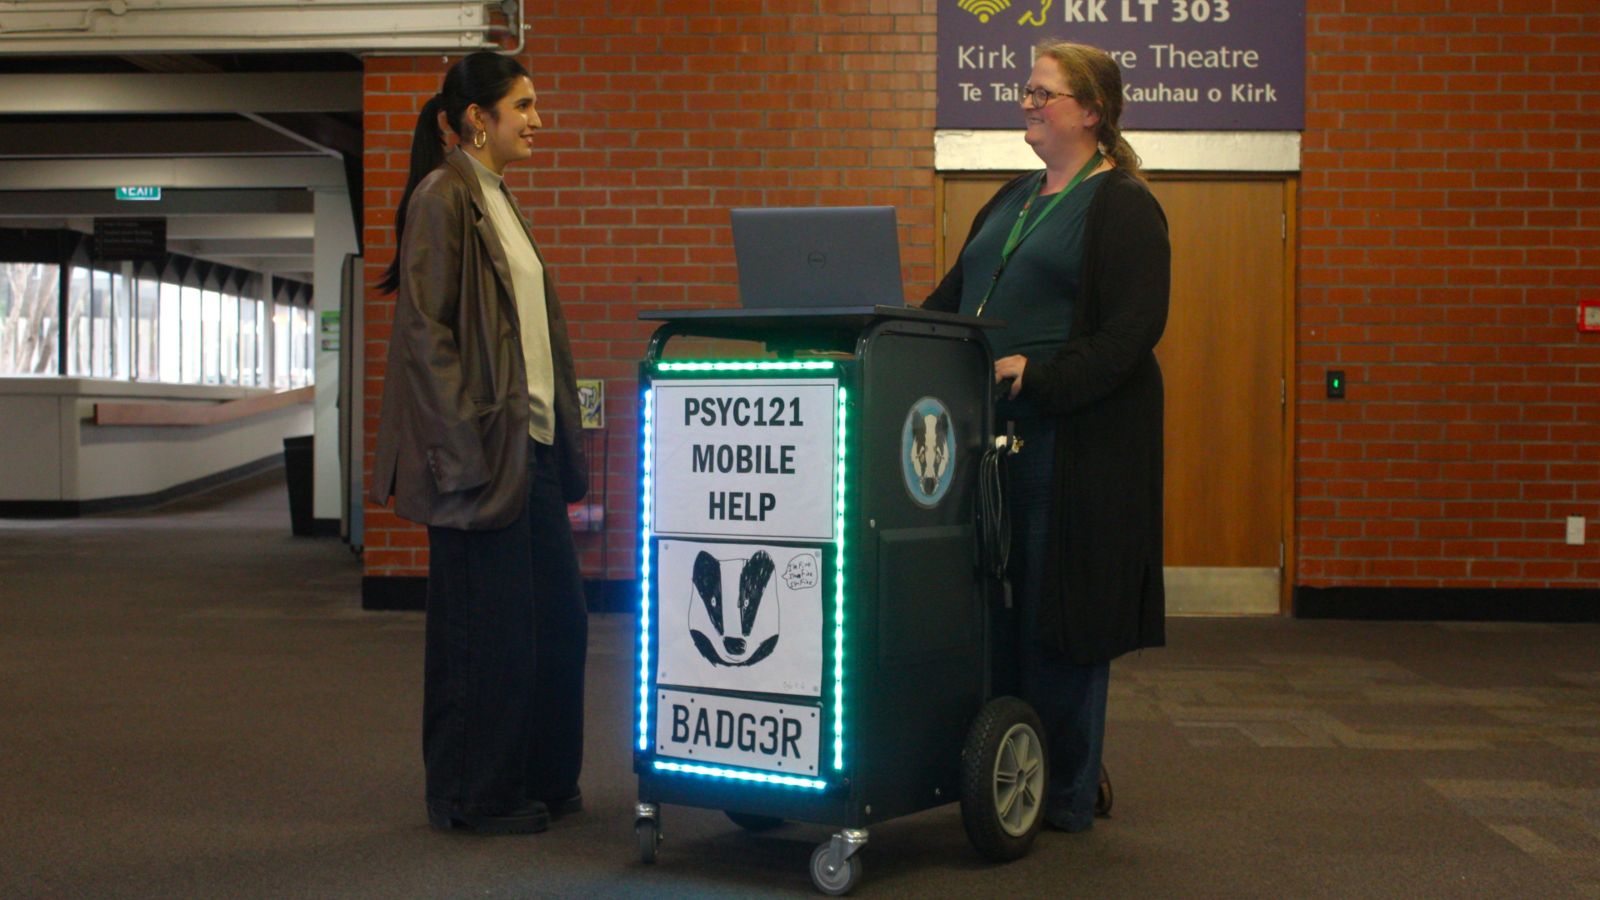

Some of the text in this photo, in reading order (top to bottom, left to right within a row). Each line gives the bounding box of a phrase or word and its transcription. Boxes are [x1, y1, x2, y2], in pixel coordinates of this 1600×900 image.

[1064, 0, 1231, 23] KK LT 303
[957, 45, 1016, 68] Kirk
[1149, 45, 1260, 68] Theatre
[958, 83, 982, 102] Te
[990, 83, 1019, 102] Tai
[1208, 87, 1222, 102] o
[1231, 84, 1278, 102] Kirk
[684, 396, 804, 427] PSYC121
[692, 443, 797, 475] MOBILE
[708, 490, 777, 522] HELP
[671, 703, 802, 759] BADG3R
